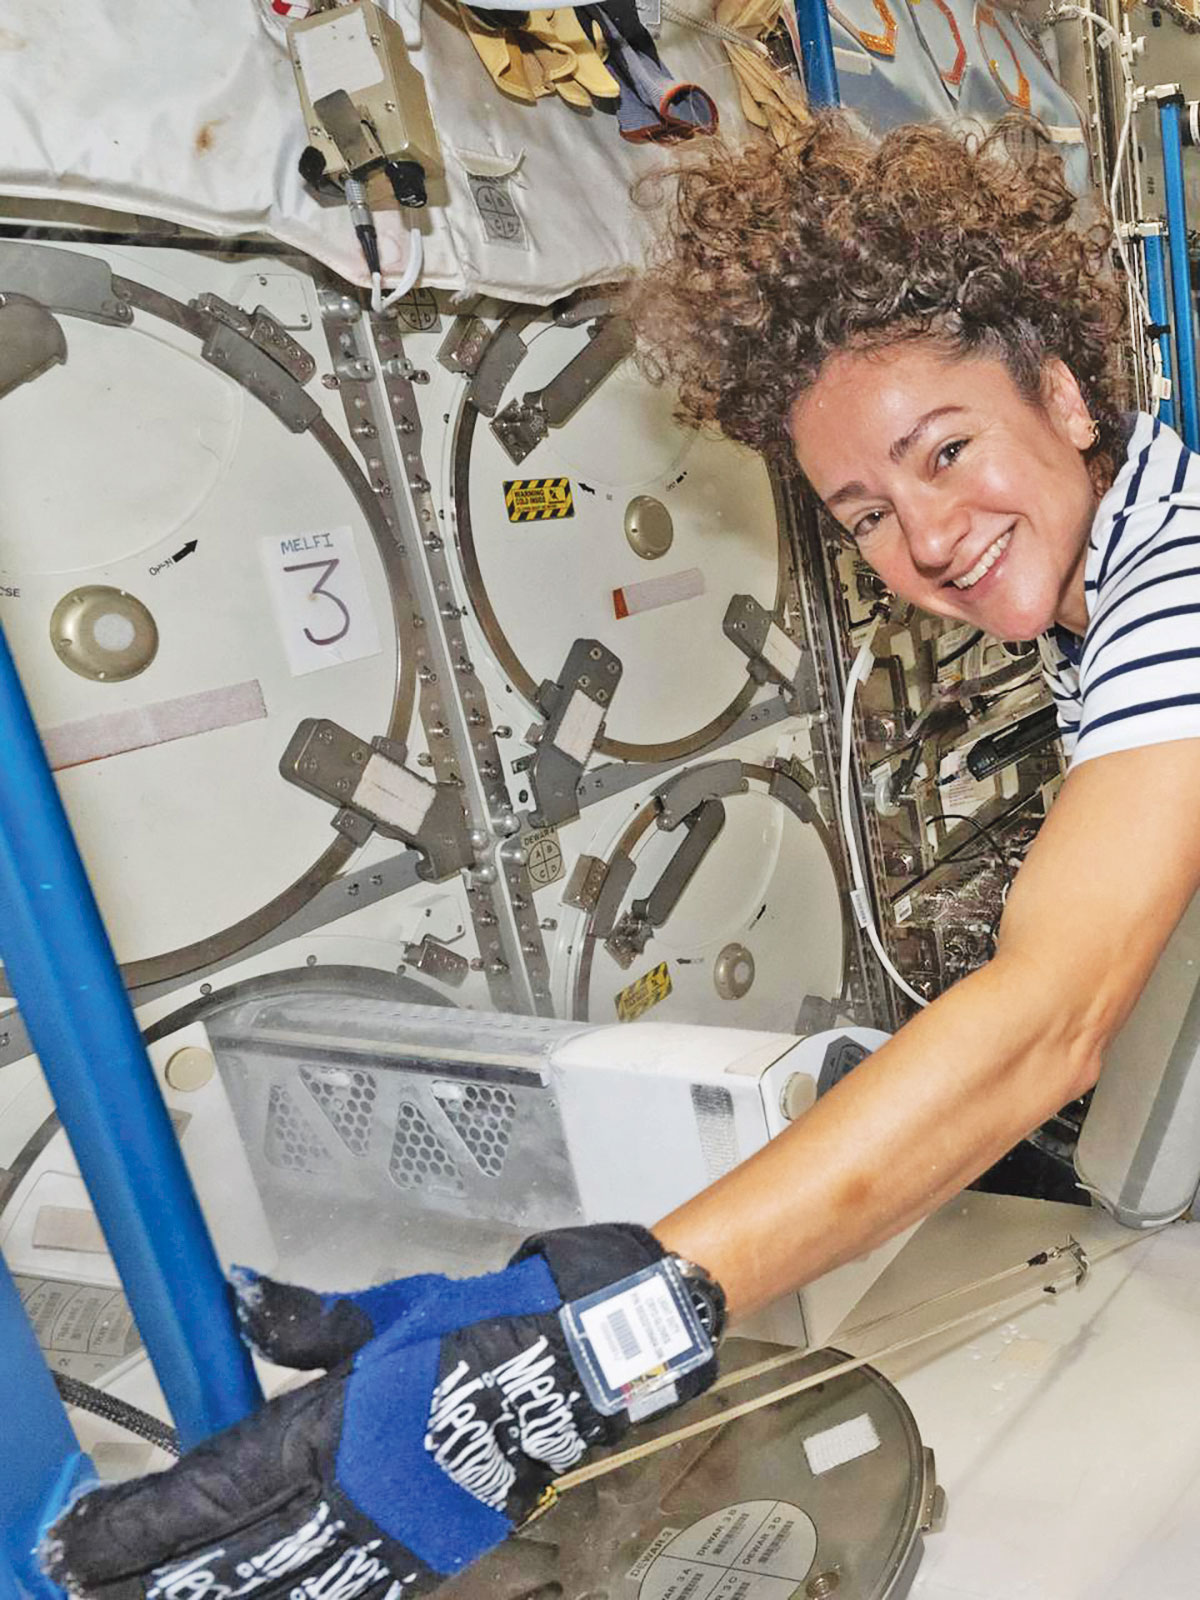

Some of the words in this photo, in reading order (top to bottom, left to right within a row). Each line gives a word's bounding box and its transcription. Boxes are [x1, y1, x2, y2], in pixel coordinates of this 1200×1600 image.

[280, 533, 335, 555] MELFI
[283, 558, 350, 646] 3
[524, 829, 549, 846] DEWAR
[696, 1524, 725, 1557] DEWAR
[742, 1530, 770, 1566] DEWAR
[630, 1541, 667, 1577] DEWAR
